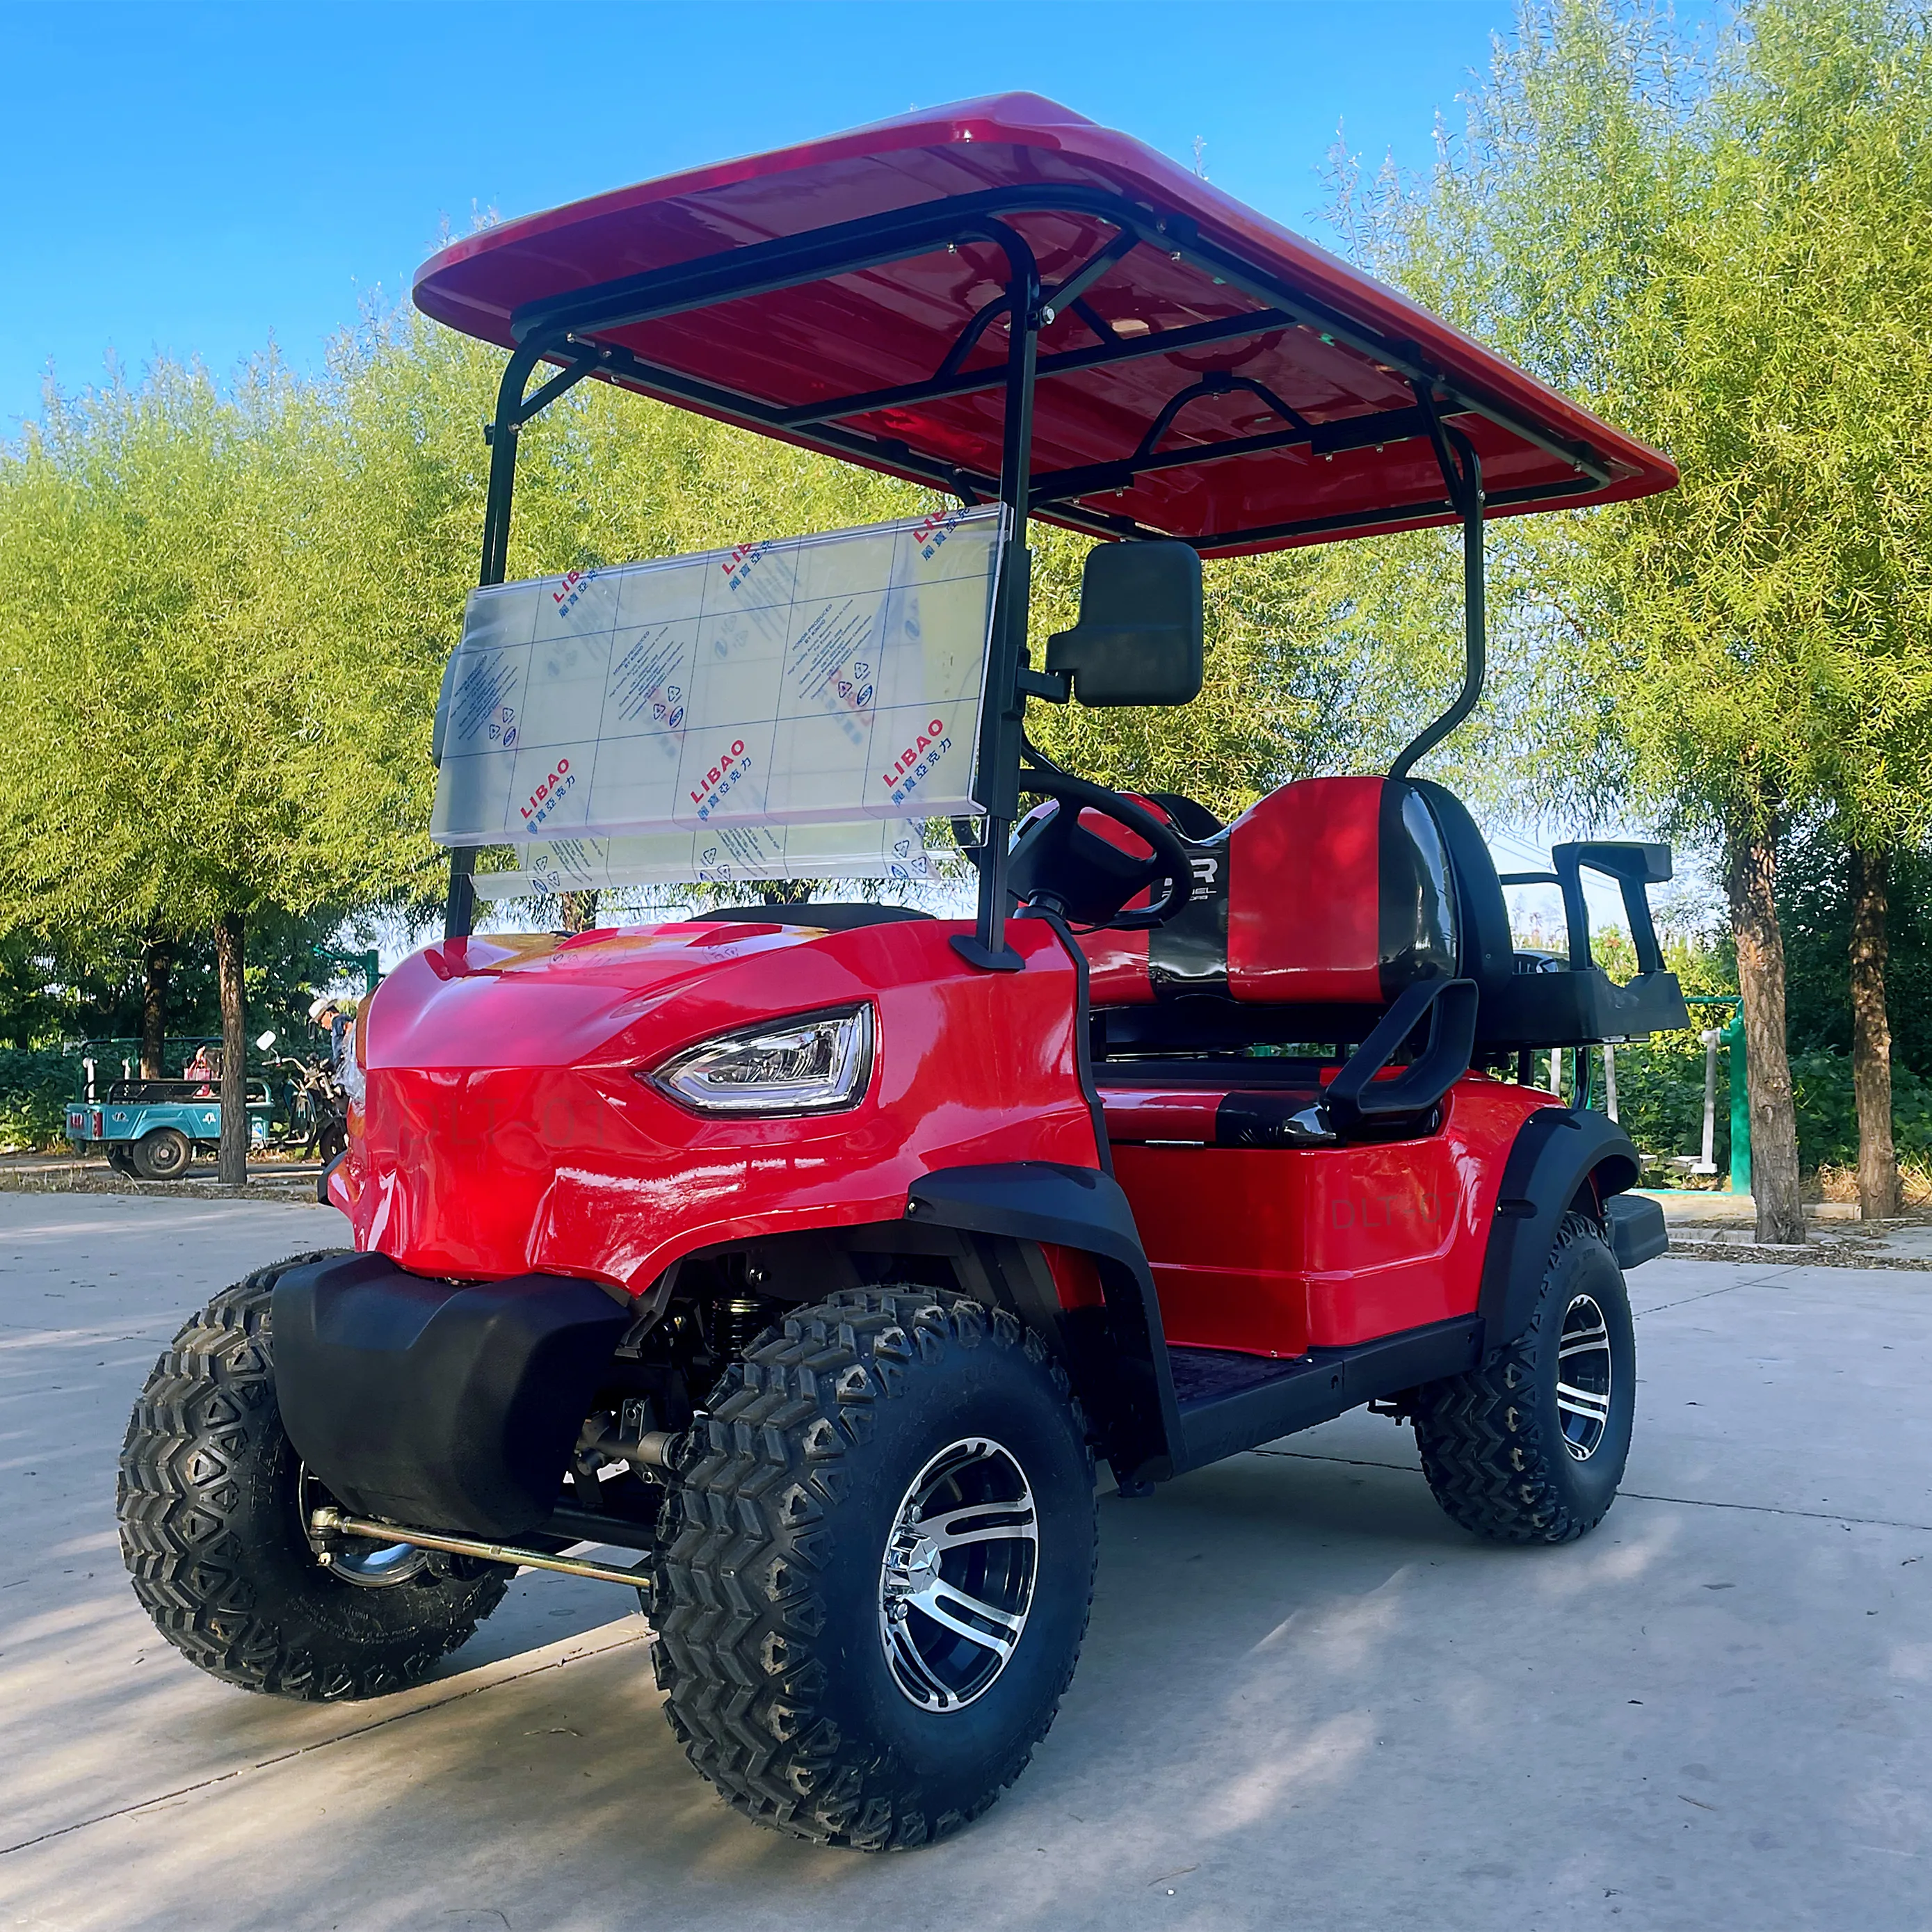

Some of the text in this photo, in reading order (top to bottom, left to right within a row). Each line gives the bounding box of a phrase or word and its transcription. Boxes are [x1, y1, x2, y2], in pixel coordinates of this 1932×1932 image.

[690, 739, 744, 803] LIBAO
[883, 719, 943, 787] LIBAO
[520, 759, 570, 819] LIBAO
